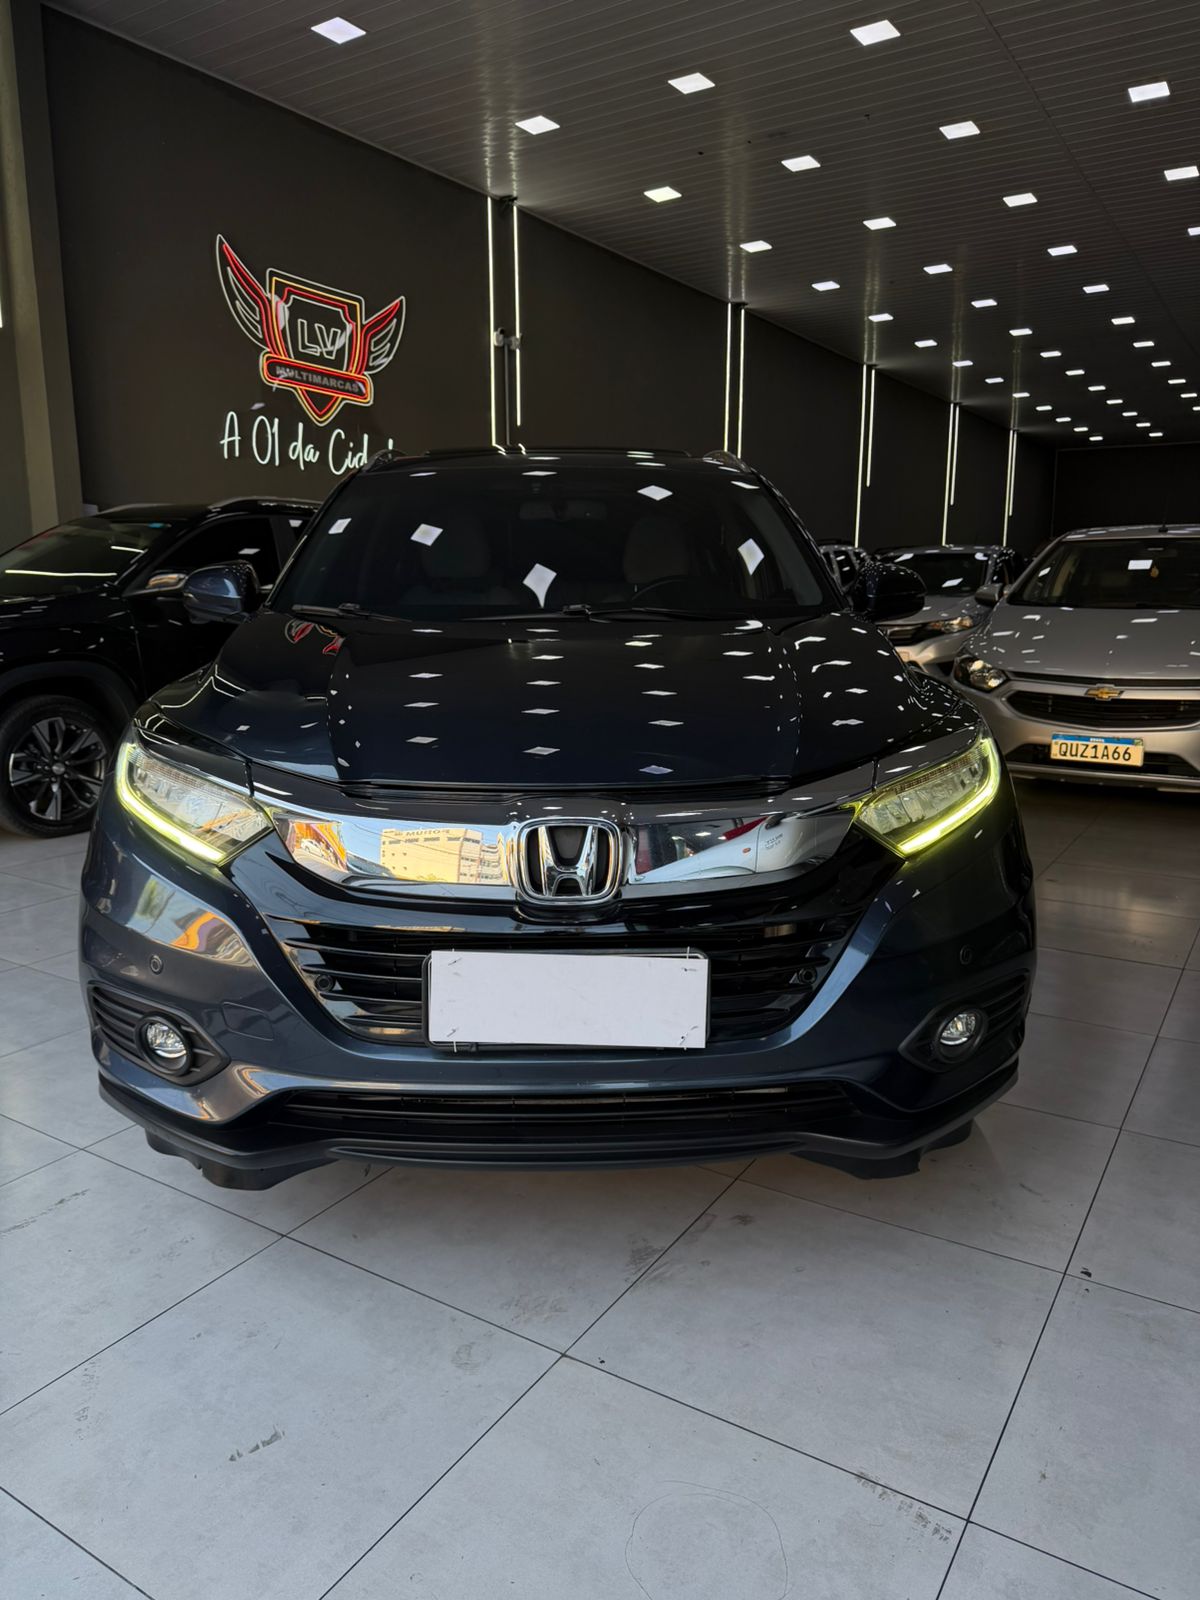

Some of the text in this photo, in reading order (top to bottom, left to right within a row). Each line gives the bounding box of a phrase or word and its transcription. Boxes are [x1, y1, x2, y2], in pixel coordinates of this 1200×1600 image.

[298, 318, 341, 360] LV
[275, 365, 359, 393] MULTIMARCAS
[219, 411, 241, 459] A
[288, 422, 320, 471] da
[1058, 742, 1132, 762] QUZ1A66
